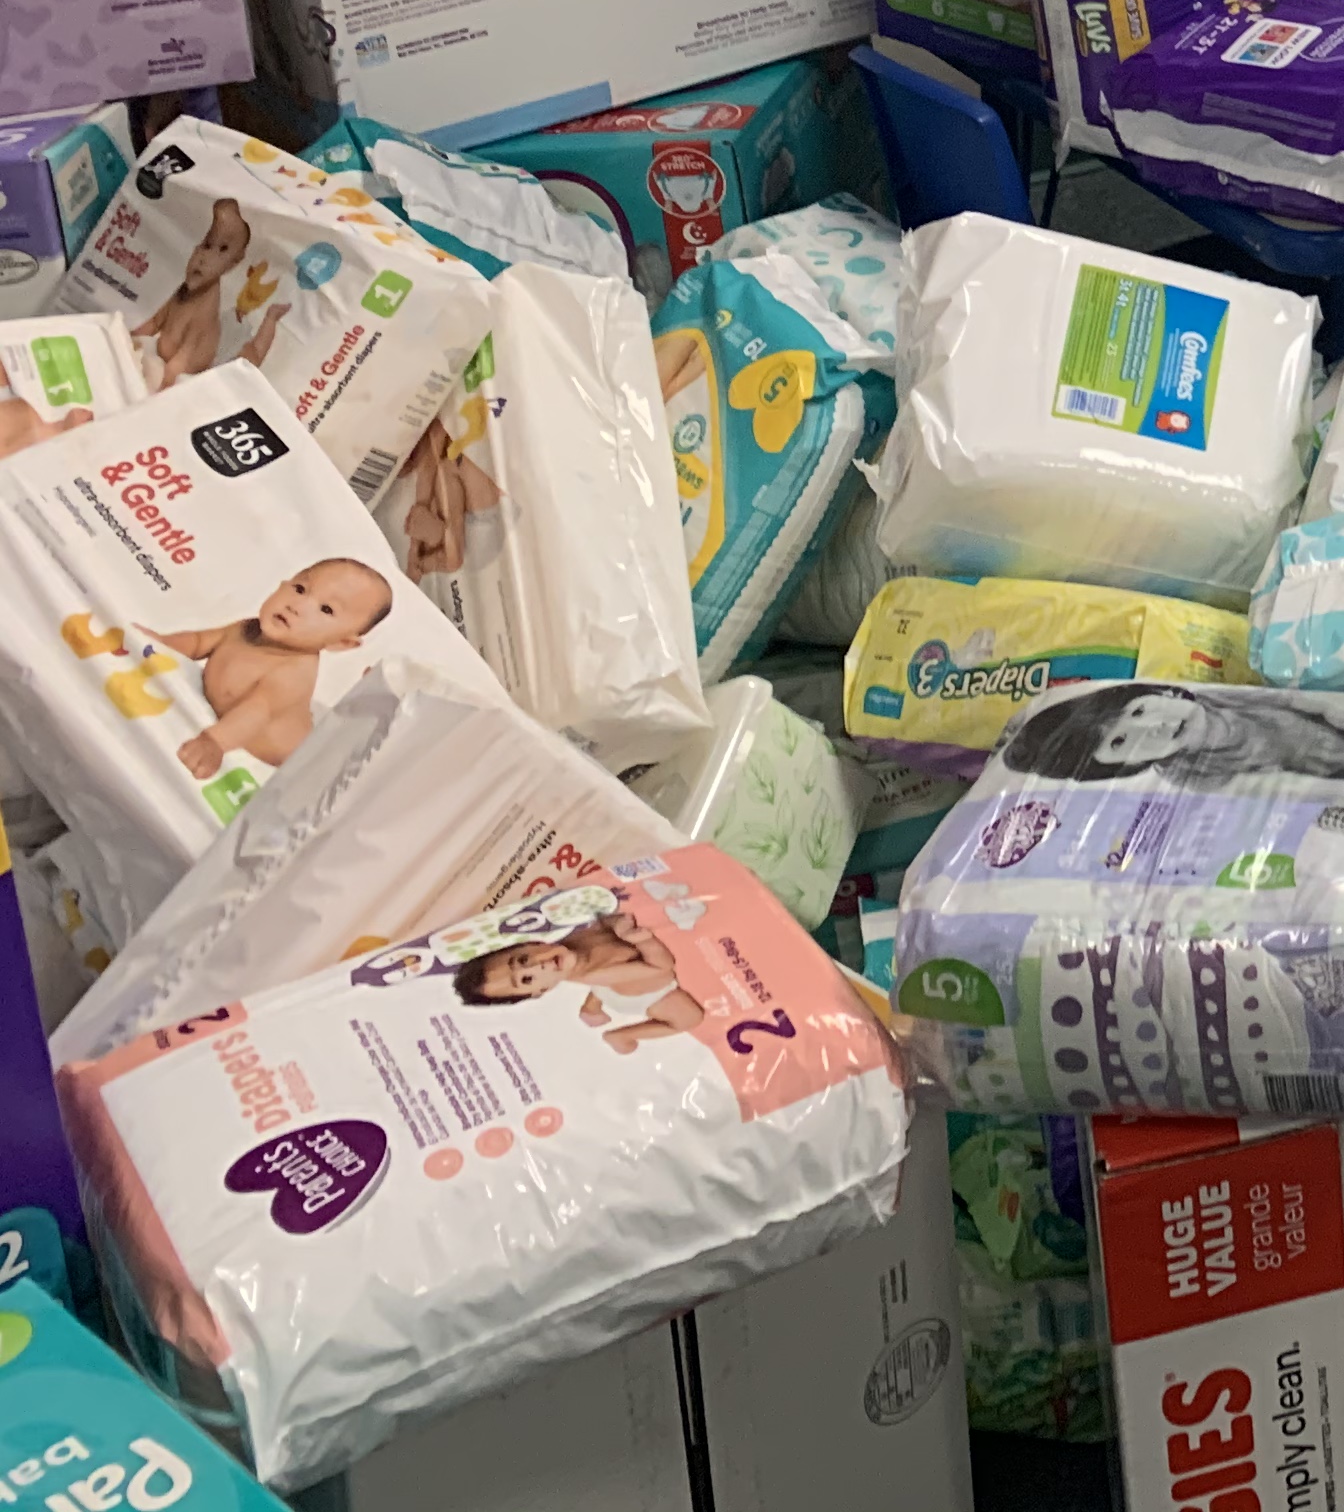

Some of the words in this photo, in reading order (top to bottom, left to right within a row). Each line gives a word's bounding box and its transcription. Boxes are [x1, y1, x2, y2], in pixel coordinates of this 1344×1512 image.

[374, 283, 404, 309] 1
[321, 324, 367, 376] Gentle
[353, 329, 383, 369] diapers
[1177, 331, 1207, 401] Comfees
[135, 444, 194, 502] Soft
[213, 419, 274, 468] 365
[100, 460, 135, 487] &
[120, 482, 197, 566] Gentle
[918, 659, 938, 695] 3
[940, 657, 1051, 701] Diapers
[726, 1008, 796, 1054] 2
[211, 1031, 291, 1134] Diapers
[254, 1140, 346, 1215] Parent's
[305, 1128, 366, 1177] CHOICE
[1162, 1195, 1198, 1299] HUGE
[1200, 1180, 1235, 1297] VALUE
[1248, 1182, 1282, 1271] grande
[1284, 1183, 1306, 1260] valeur
[1275, 1341, 1306, 1438] clean.
